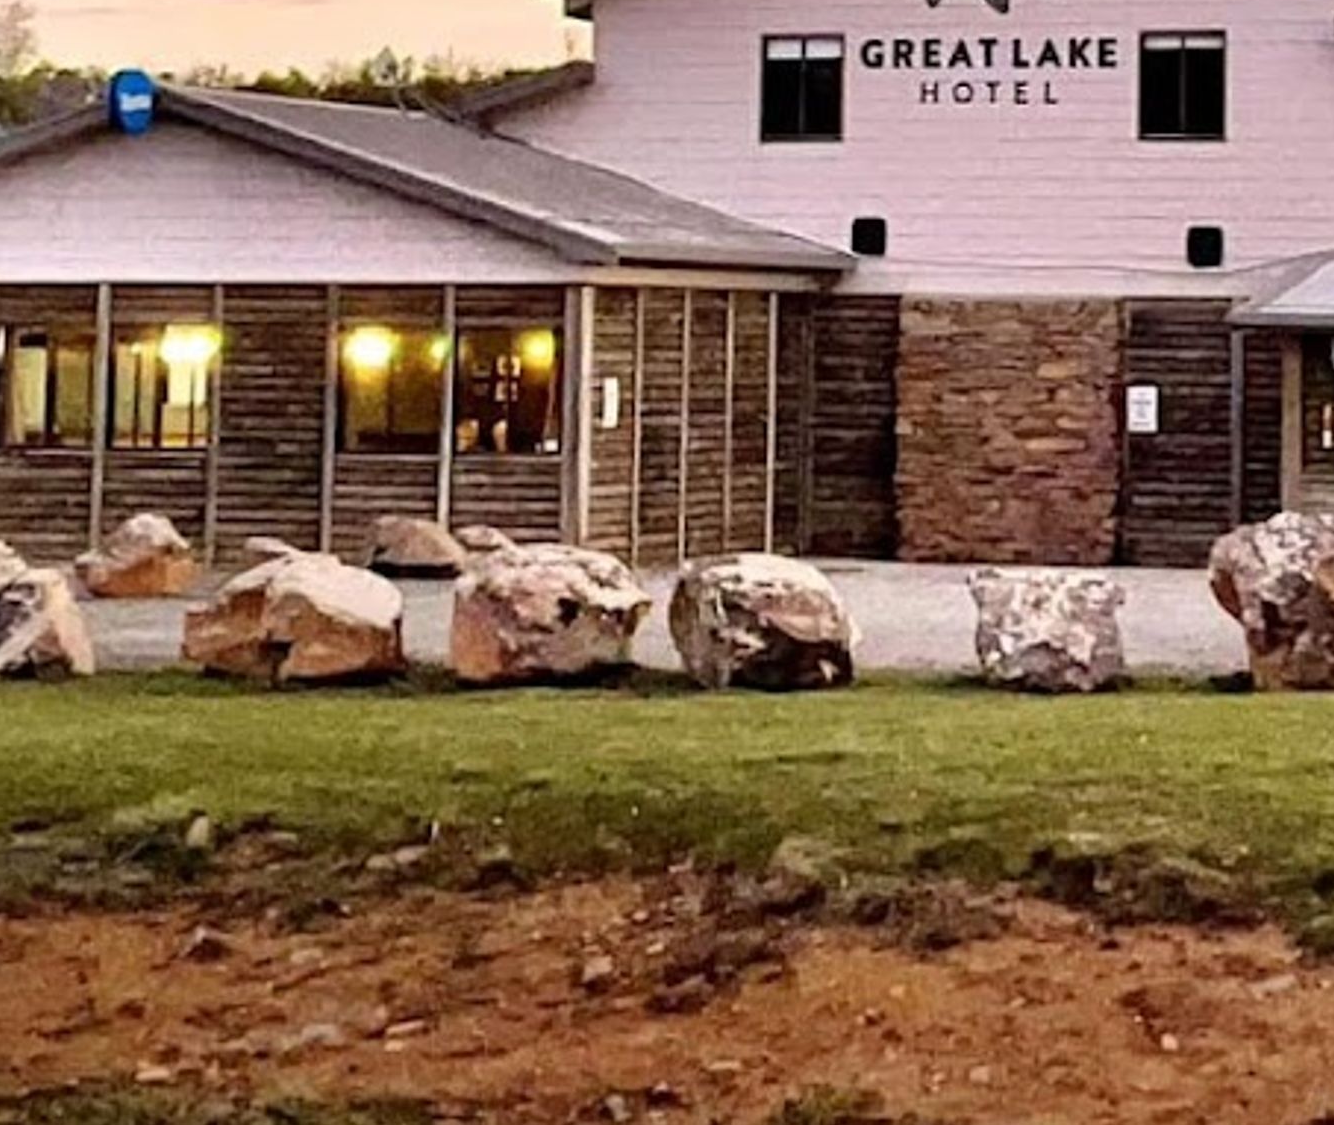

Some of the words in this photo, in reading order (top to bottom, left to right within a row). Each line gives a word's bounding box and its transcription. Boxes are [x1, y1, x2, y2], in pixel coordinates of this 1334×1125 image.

[860, 38, 998, 69] GREAT
[1012, 38, 1117, 69] LAKE
[920, 81, 1058, 105] HOTEL
